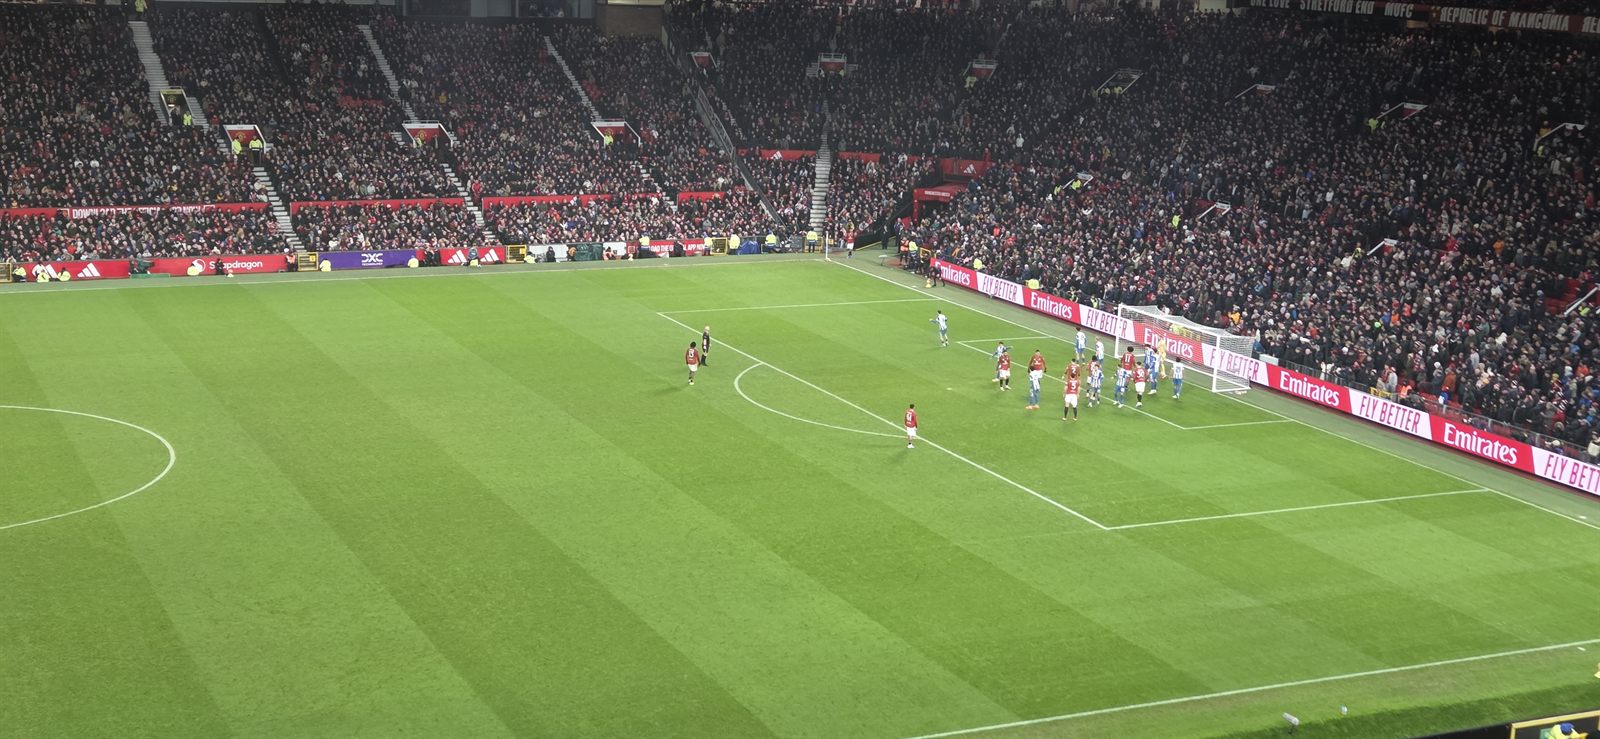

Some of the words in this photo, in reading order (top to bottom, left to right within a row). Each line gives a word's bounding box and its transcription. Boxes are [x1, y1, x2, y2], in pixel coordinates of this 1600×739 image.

[1300, 0, 1353, 14] STRETFORD
[1355, 1, 1375, 15] END
[1384, 2, 1415, 18] MUFC
[1491, 10, 1508, 27] OF
[209, 260, 263, 270] Sapdragon
[982, 275, 993, 295] FLY
[993, 279, 1018, 303] BETTER
[1030, 291, 1073, 320] Emirates
[1086, 308, 1099, 329] FLY
[1100, 312, 1128, 338] BETTR
[1209, 347, 1225, 370] FY
[1280, 370, 1341, 408] Emirates
[1360, 395, 1379, 420] FLY
[1380, 402, 1421, 434] BETTER
[1443, 421, 1518, 465] Emirates
[1544, 454, 1568, 482] FLY
[1569, 462, 1600, 494] BETT
